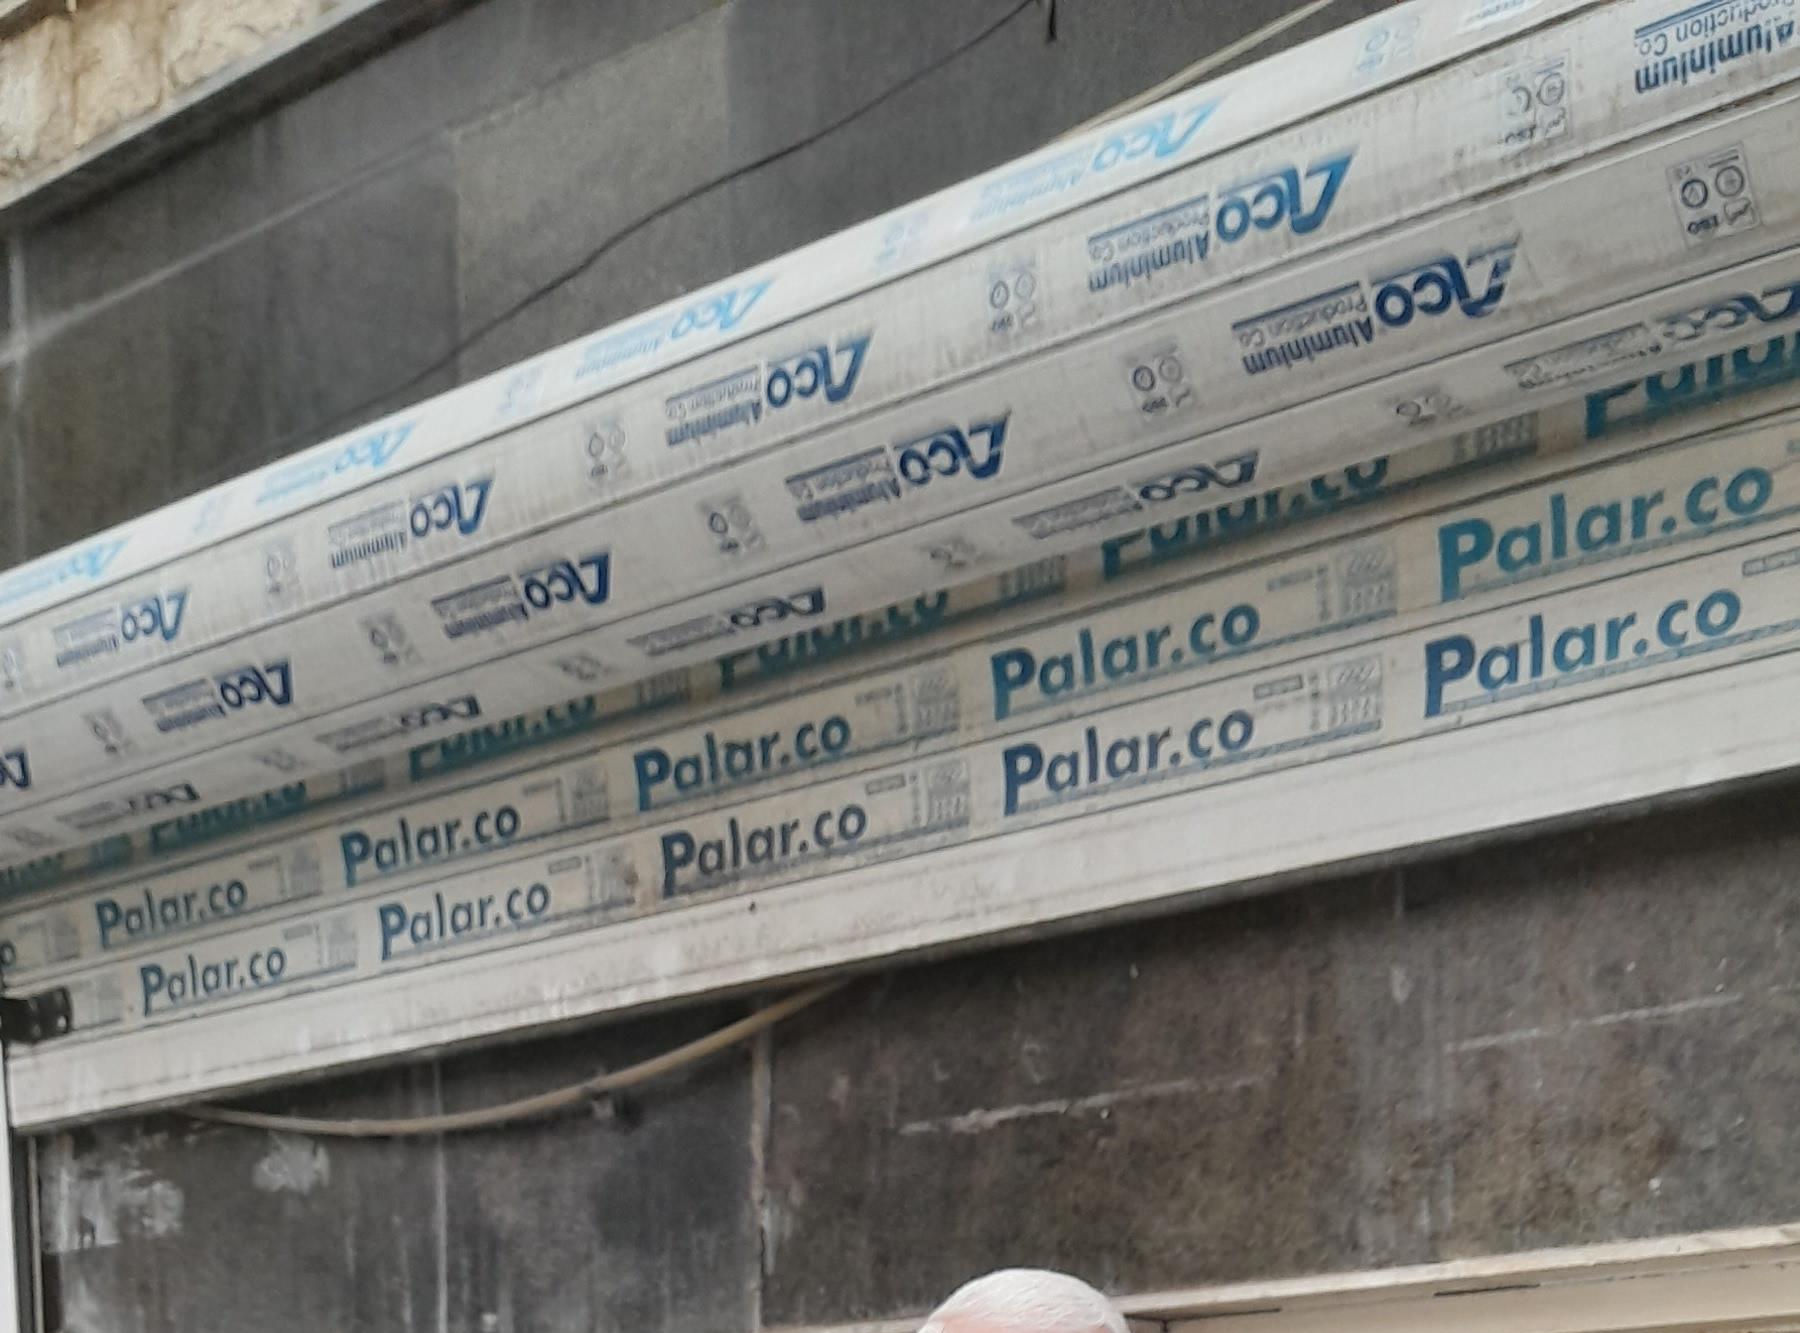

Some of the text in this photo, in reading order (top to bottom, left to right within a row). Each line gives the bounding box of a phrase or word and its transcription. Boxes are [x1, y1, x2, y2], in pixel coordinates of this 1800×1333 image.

[1635, 20, 1795, 95] Aluminium
[1438, 466, 1773, 602] Palar.co
[991, 603, 1260, 721] Palar.co
[1425, 588, 1742, 719] Palar.co
[634, 715, 852, 812] Palar.co
[1003, 709, 1254, 816] Palar.co
[340, 803, 520, 887] Palar.co
[661, 803, 867, 899] Palar.co
[96, 876, 248, 950] Palar.co
[379, 880, 551, 962] Palar.co
[140, 943, 287, 1017] Palar.co
